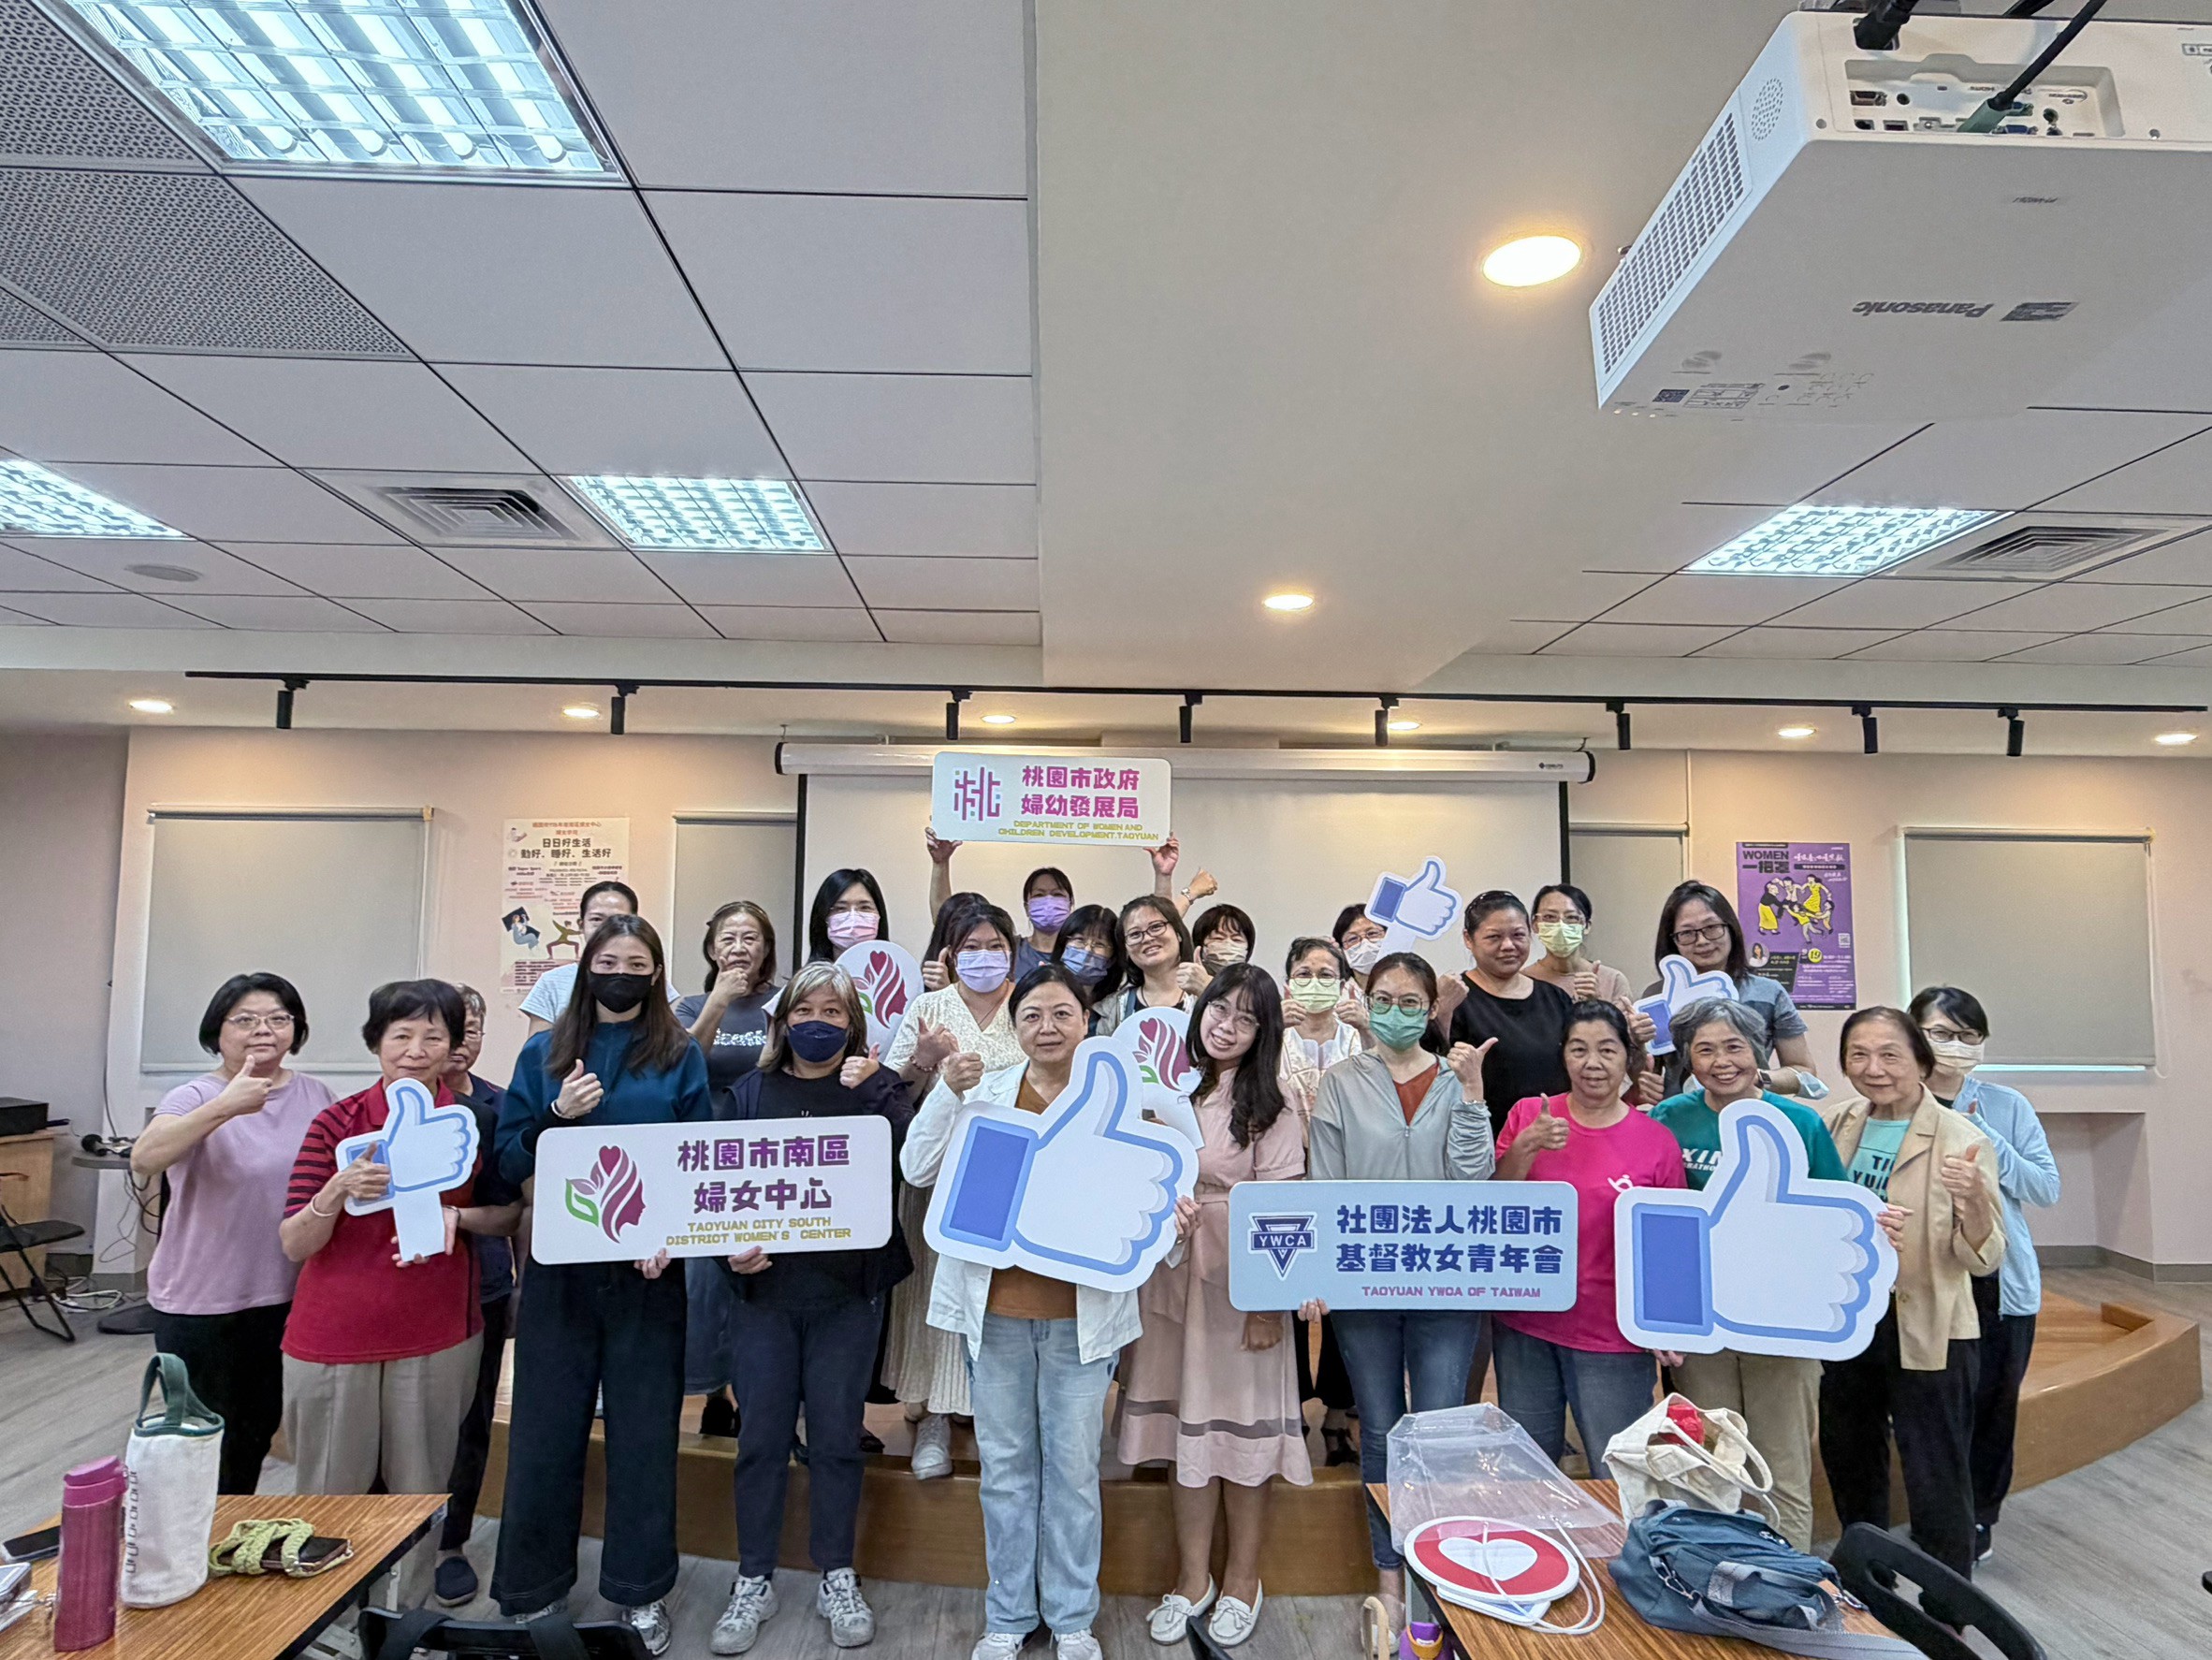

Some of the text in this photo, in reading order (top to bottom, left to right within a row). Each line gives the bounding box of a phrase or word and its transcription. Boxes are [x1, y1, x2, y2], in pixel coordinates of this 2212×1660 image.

[1852, 301, 1994, 318] Panasonic
[1022, 764, 1140, 791] 桃園市政府
[1021, 794, 1139, 819] 婦幼發展局
[998, 828, 1044, 837] CHILDREN
[1013, 820, 1074, 829] DEPARTMENT
[543, 837, 591, 848] 日日好生活
[1742, 851, 1789, 860] WOMEN
[1811, 951, 1821, 959] 19
[677, 1134, 851, 1172] 桃園市南區
[693, 1177, 832, 1214] 婦女中心
[687, 1216, 831, 1232] TAOYUAN CITY SOUTH
[1336, 1204, 1563, 1236] 社團法人桃園市
[665, 1233, 730, 1245] DISTRICT
[800, 1228, 851, 1240] CENTER
[1259, 1235, 1307, 1247] YWCA
[1336, 1243, 1564, 1274] 基督教女青年會
[1361, 1286, 1423, 1297] TAOYUAN
[1427, 1286, 1463, 1297] YWCA
[1467, 1287, 1486, 1297] OF
